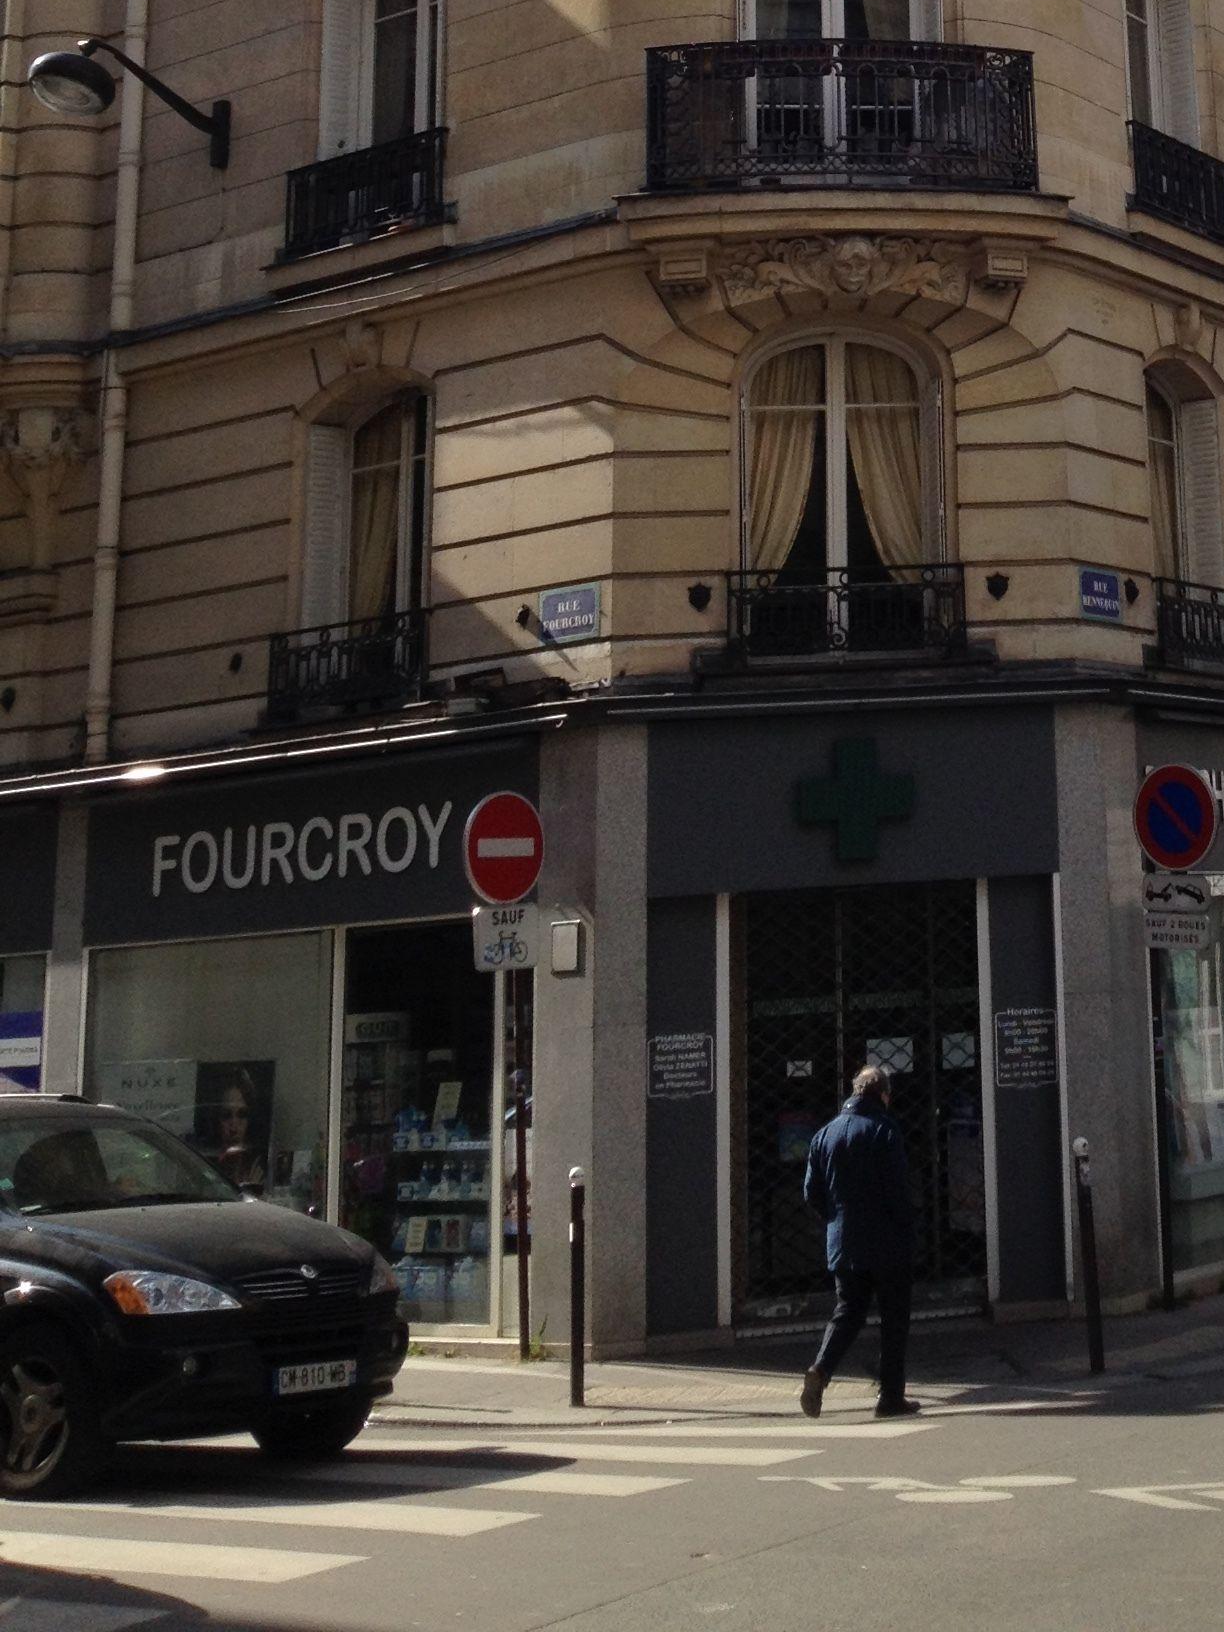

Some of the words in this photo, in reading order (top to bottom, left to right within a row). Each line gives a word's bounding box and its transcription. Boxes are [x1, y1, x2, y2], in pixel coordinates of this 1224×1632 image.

[1093, 580, 1109, 594] RUE
[557, 599, 580, 613] RUE
[152, 801, 453, 897] FOURCROY
[492, 909, 525, 926] SAUF
[1146, 919, 1167, 928] SAUF
[1170, 921, 1176, 929] 2
[1007, 1008, 1044, 1016] Horaires
[655, 1033, 706, 1042] PHARMACIE
[656, 1041, 704, 1051] FOURCROY
[121, 1077, 177, 1089] NUXE
